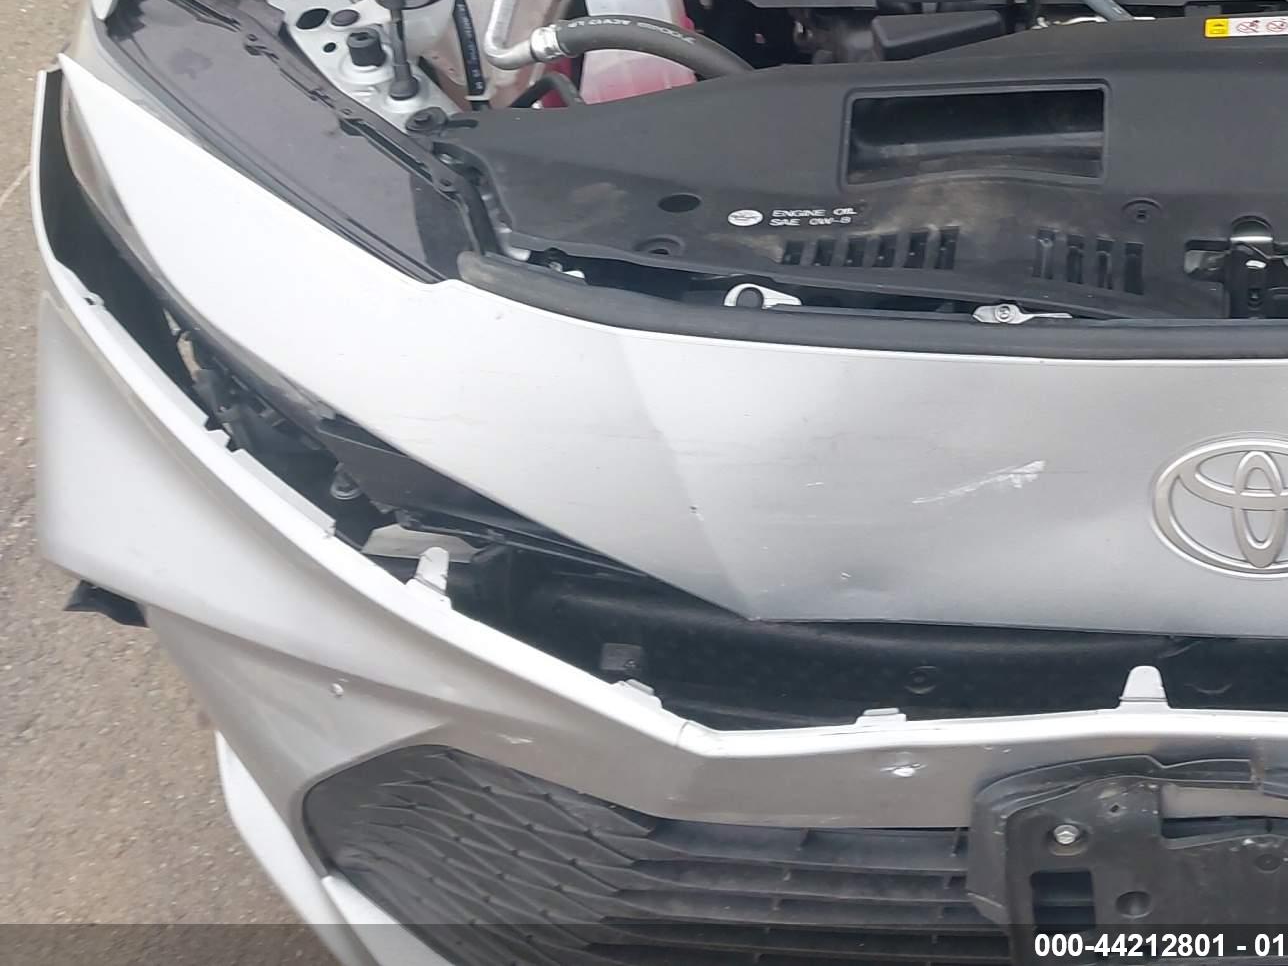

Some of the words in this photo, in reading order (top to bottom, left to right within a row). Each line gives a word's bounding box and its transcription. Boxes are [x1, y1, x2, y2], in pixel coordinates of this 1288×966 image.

[772, 209, 827, 217] ENGINE
[833, 207, 858, 216] OIL
[769, 218, 801, 226] SAE
